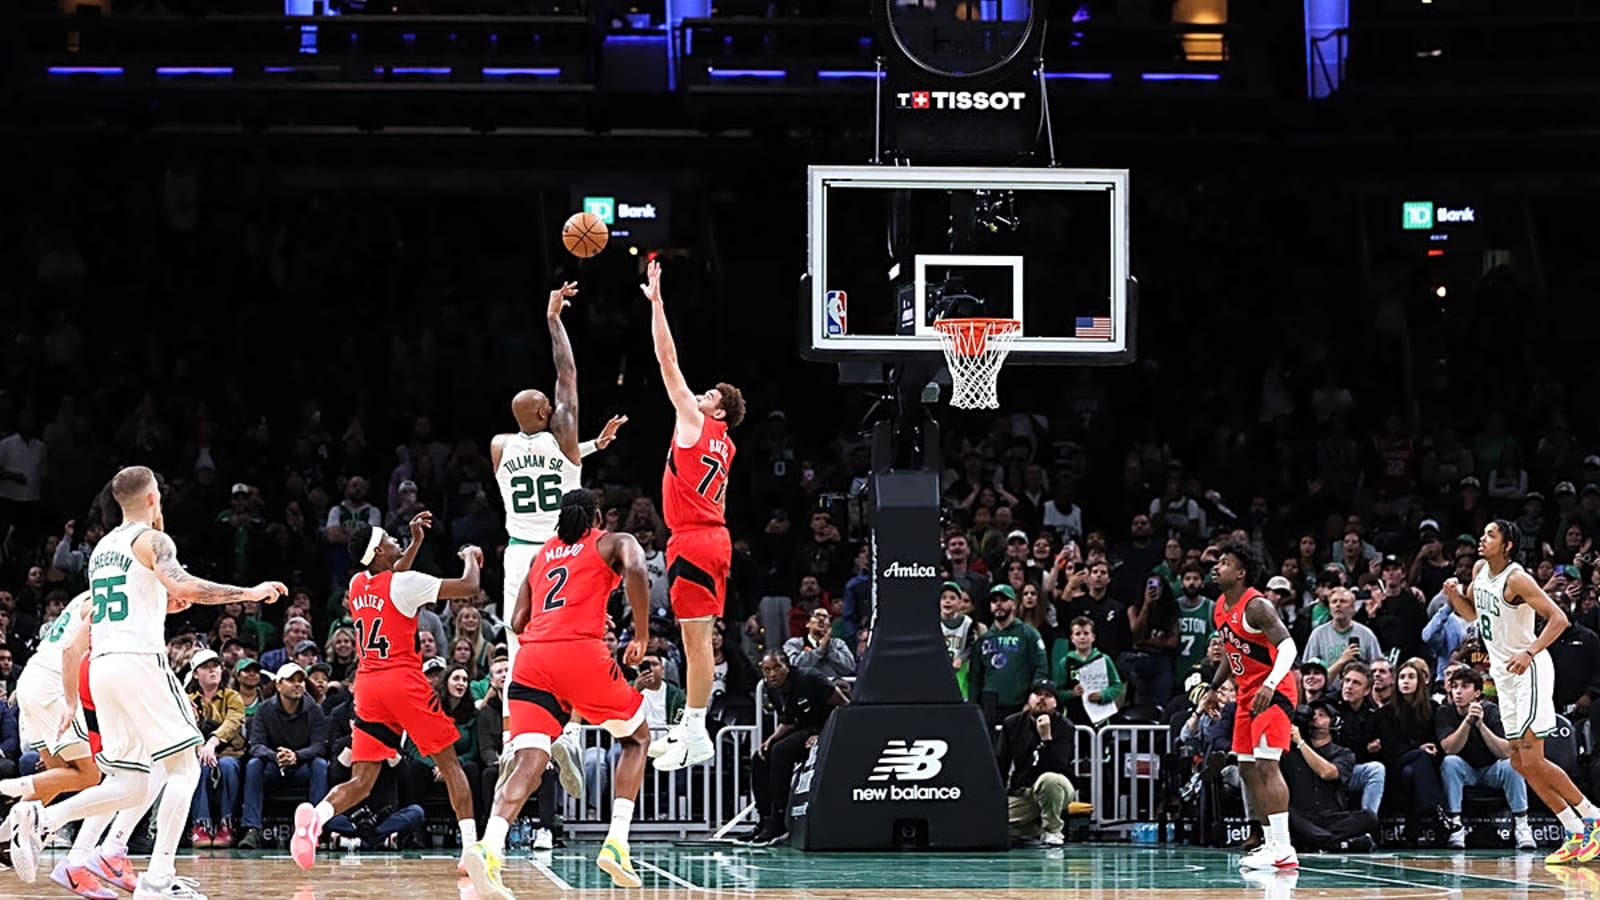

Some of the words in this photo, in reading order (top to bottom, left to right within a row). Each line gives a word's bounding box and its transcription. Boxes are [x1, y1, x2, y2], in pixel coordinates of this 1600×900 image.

[931, 91, 1026, 110] TISSOT
[618, 203, 656, 218] Bank
[1405, 206, 1431, 224] TD
[1437, 206, 1475, 222] Bank
[503, 454, 546, 475] TILLMAN
[510, 473, 562, 514] 26
[884, 562, 936, 578] Amica
[92, 574, 128, 624] 55
[543, 565, 569, 612] 2
[353, 617, 390, 659] 14
[1481, 614, 1493, 641] 8
[1180, 635, 1195, 656] 7
[853, 786, 887, 801] new
[890, 784, 961, 801] balance
